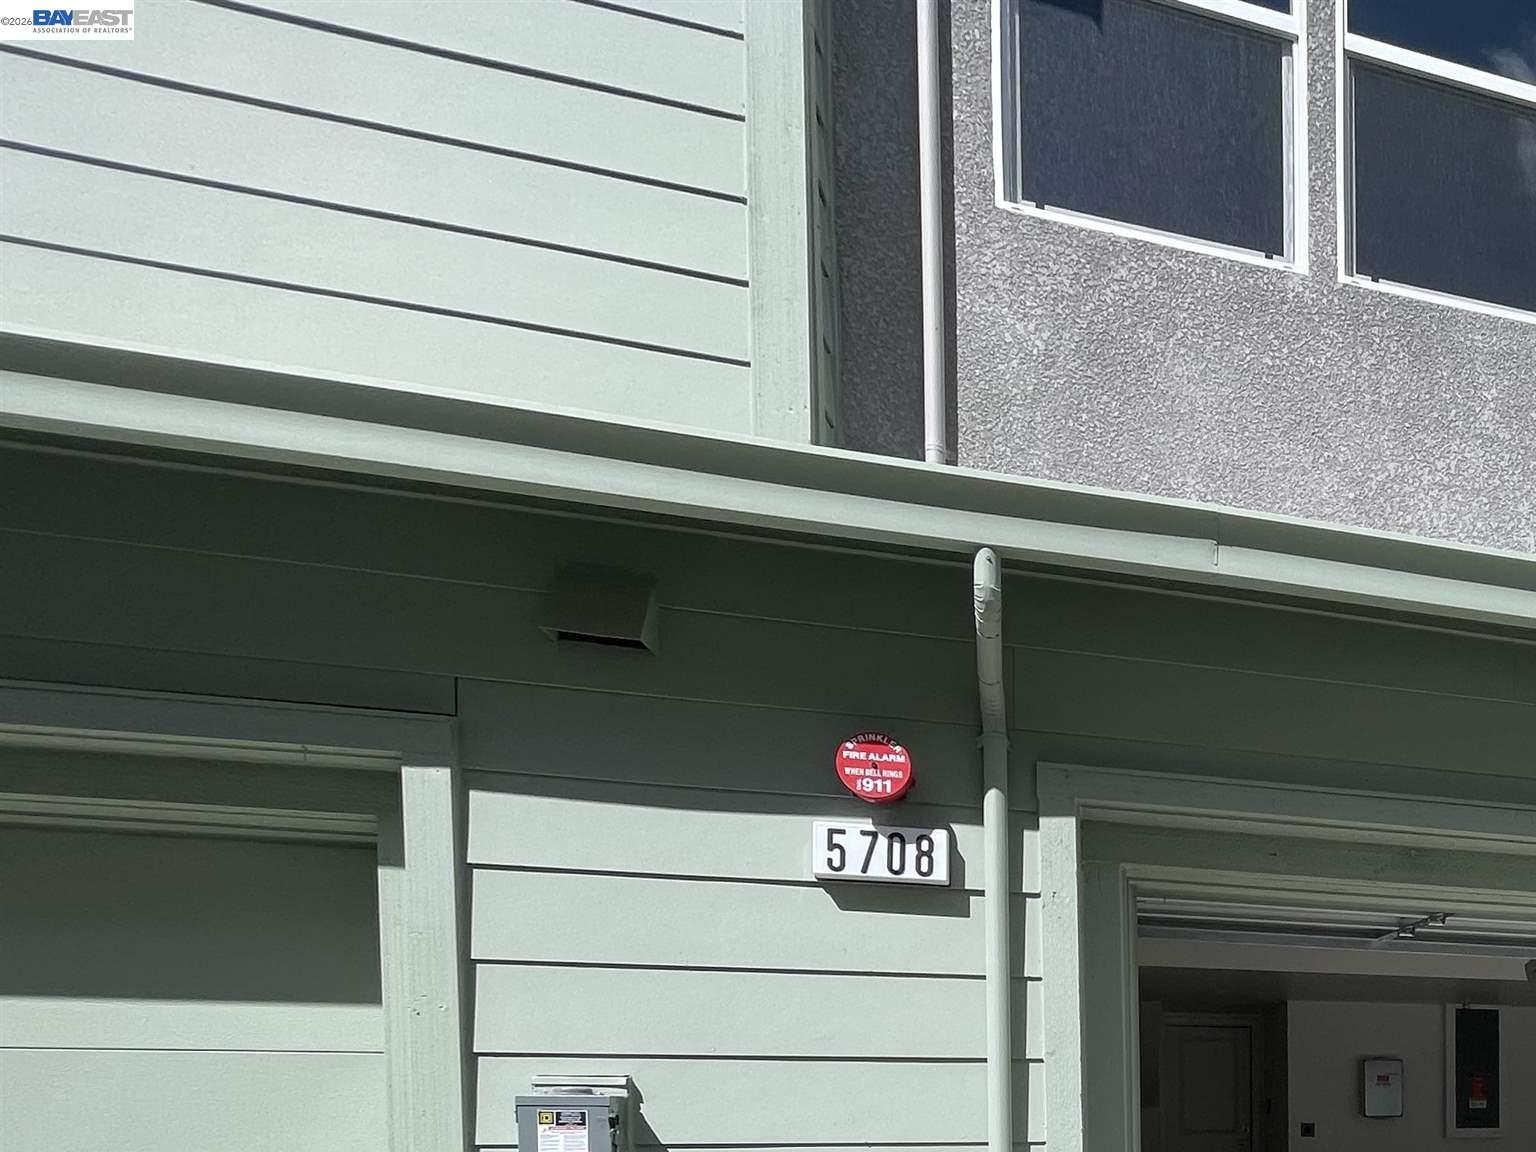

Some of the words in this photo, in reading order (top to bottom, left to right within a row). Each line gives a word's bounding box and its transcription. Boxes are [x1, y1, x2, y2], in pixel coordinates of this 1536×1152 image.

[845, 733, 902, 754] SPRINKLER
[842, 751, 867, 760] FIRE
[868, 752, 905, 762] ALARM
[844, 767, 864, 776] WHEN
[865, 768, 882, 778] BELL
[882, 769, 903, 779] RINGS
[862, 778, 892, 793] 911
[826, 828, 934, 877] 5708
